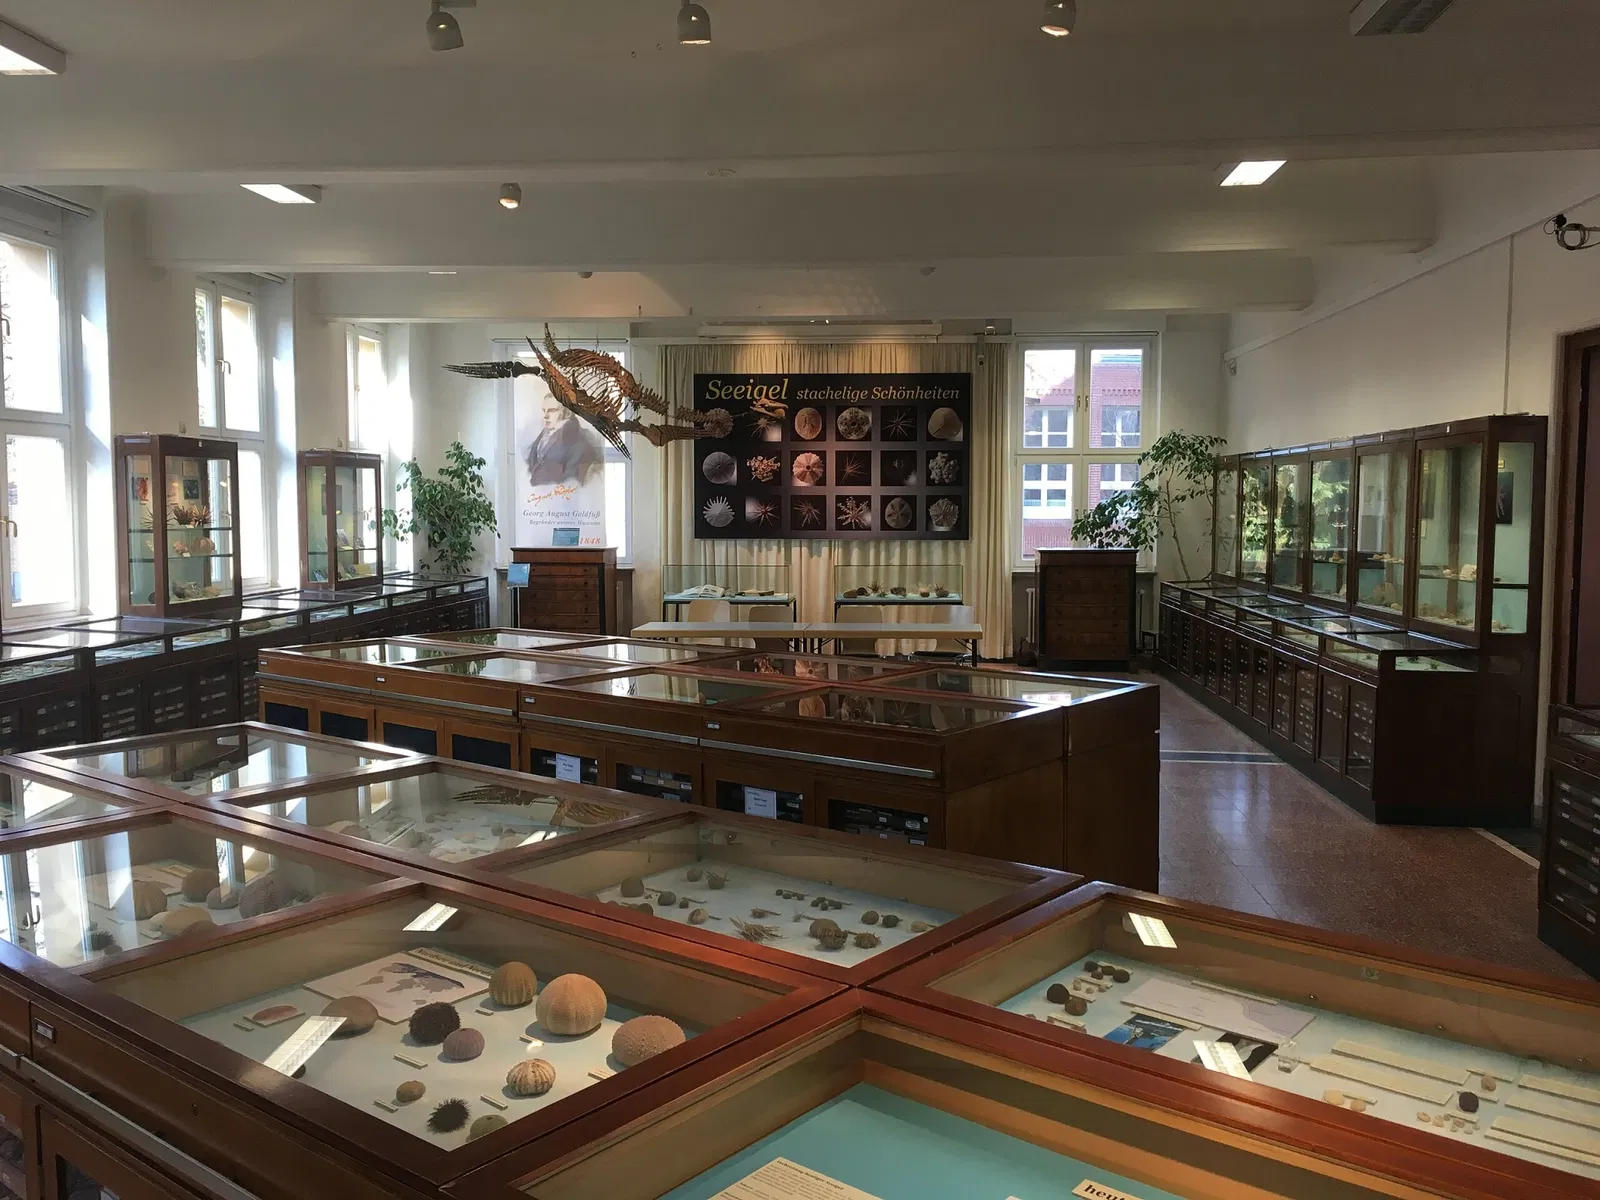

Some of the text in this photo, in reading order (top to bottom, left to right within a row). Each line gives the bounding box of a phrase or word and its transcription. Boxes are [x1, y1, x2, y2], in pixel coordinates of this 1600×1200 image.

[705, 378, 960, 403] Seeigel stachelige Schönheiten
[523, 509, 601, 519] Georg August Goldfuß
[580, 537, 601, 545] 1848
